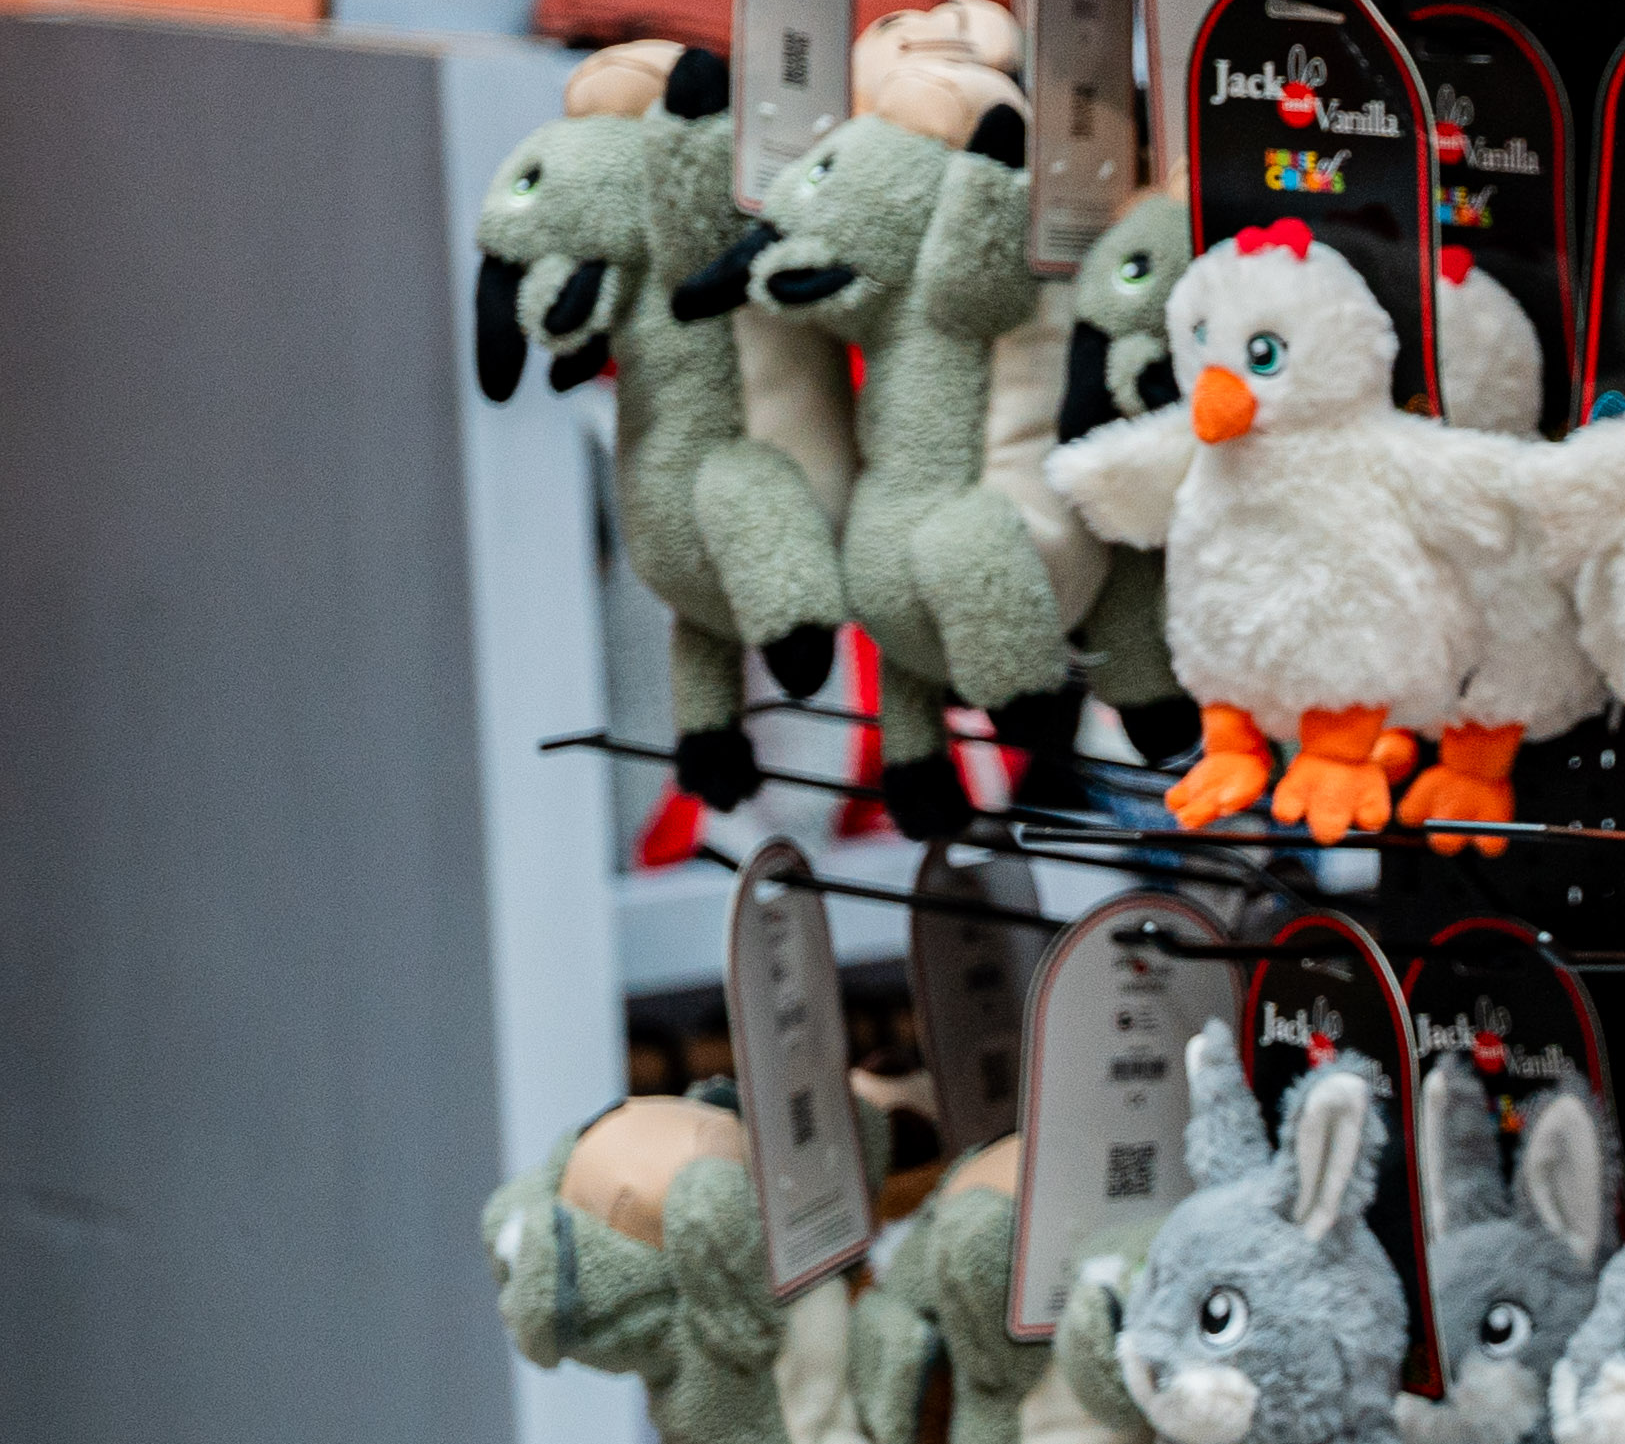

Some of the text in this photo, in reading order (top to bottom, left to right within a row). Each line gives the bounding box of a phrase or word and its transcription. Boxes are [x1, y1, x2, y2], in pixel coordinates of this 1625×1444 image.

[1210, 58, 1287, 105] Jack
[1314, 97, 1401, 138] Vanilla
[1258, 1001, 1311, 1047] Jack
[1416, 1012, 1477, 1060] Jack
